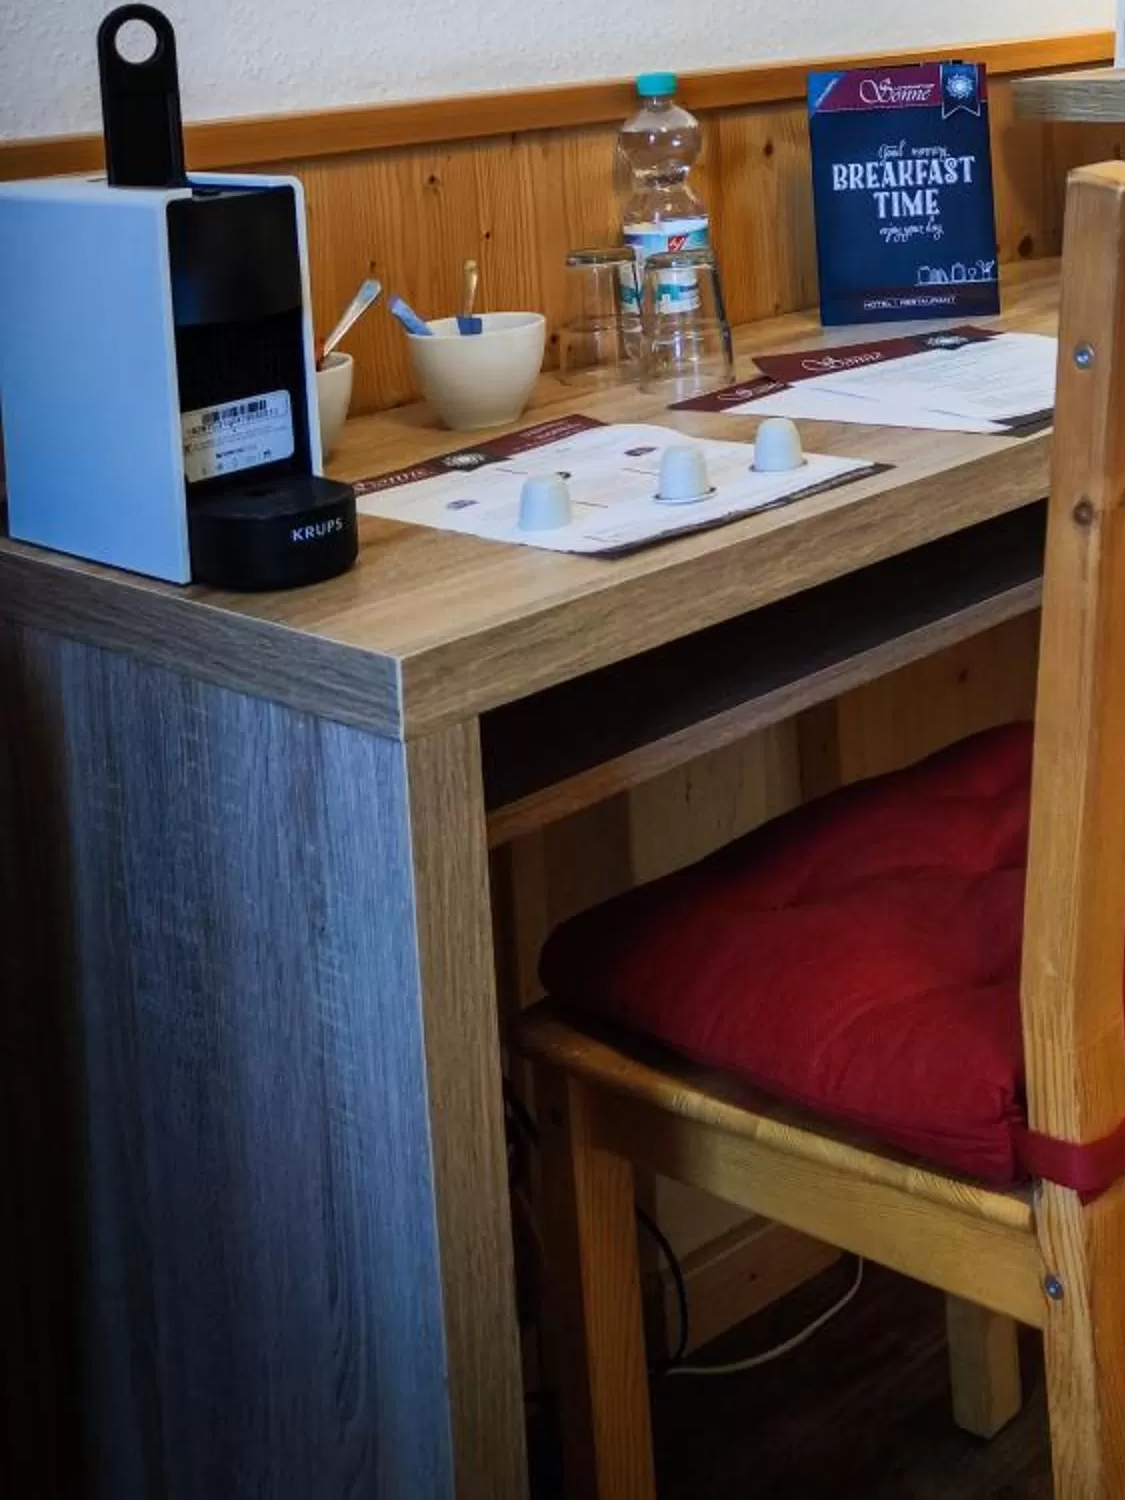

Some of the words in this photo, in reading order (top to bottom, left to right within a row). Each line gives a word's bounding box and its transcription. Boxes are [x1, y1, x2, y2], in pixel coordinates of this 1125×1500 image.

[859, 77, 935, 105] Sonne
[831, 156, 976, 191] BREAKFAST
[873, 188, 940, 219] TIME
[291, 517, 343, 542] KRUPS
